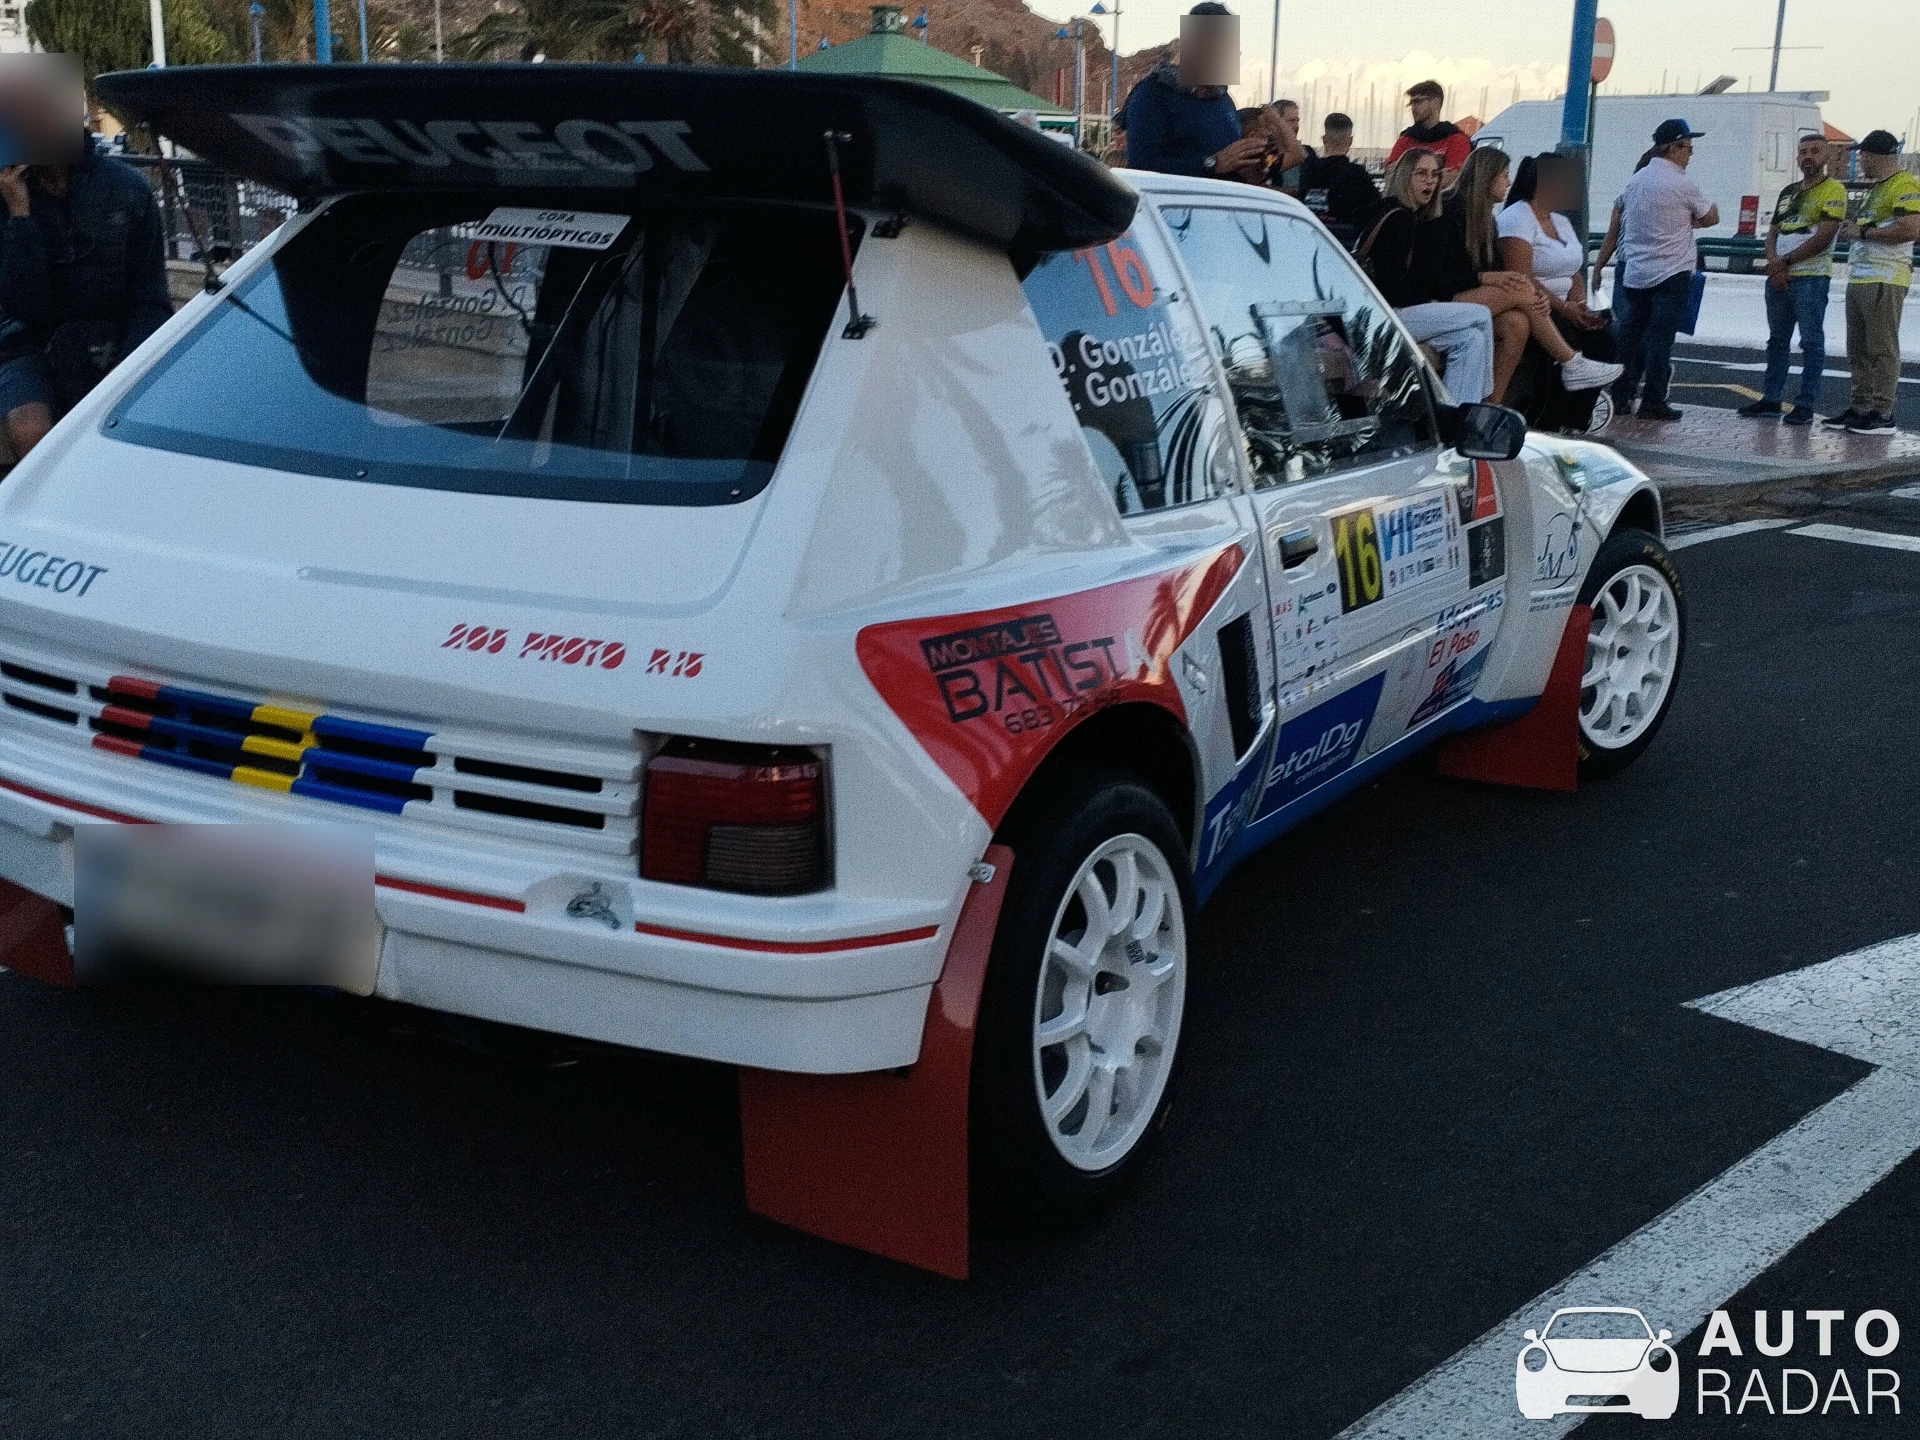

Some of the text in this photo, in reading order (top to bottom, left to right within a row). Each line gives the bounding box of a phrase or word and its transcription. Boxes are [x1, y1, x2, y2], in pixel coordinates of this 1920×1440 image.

[229, 112, 711, 173] PEUGEOT
[537, 212, 576, 224] COPA
[1073, 231, 1154, 317] 16
[0, 542, 109, 597] UGEOT
[1336, 513, 1381, 608] 16
[440, 623, 509, 654] 205
[517, 632, 627, 670] PROTO
[929, 621, 1060, 668] MONTAJES
